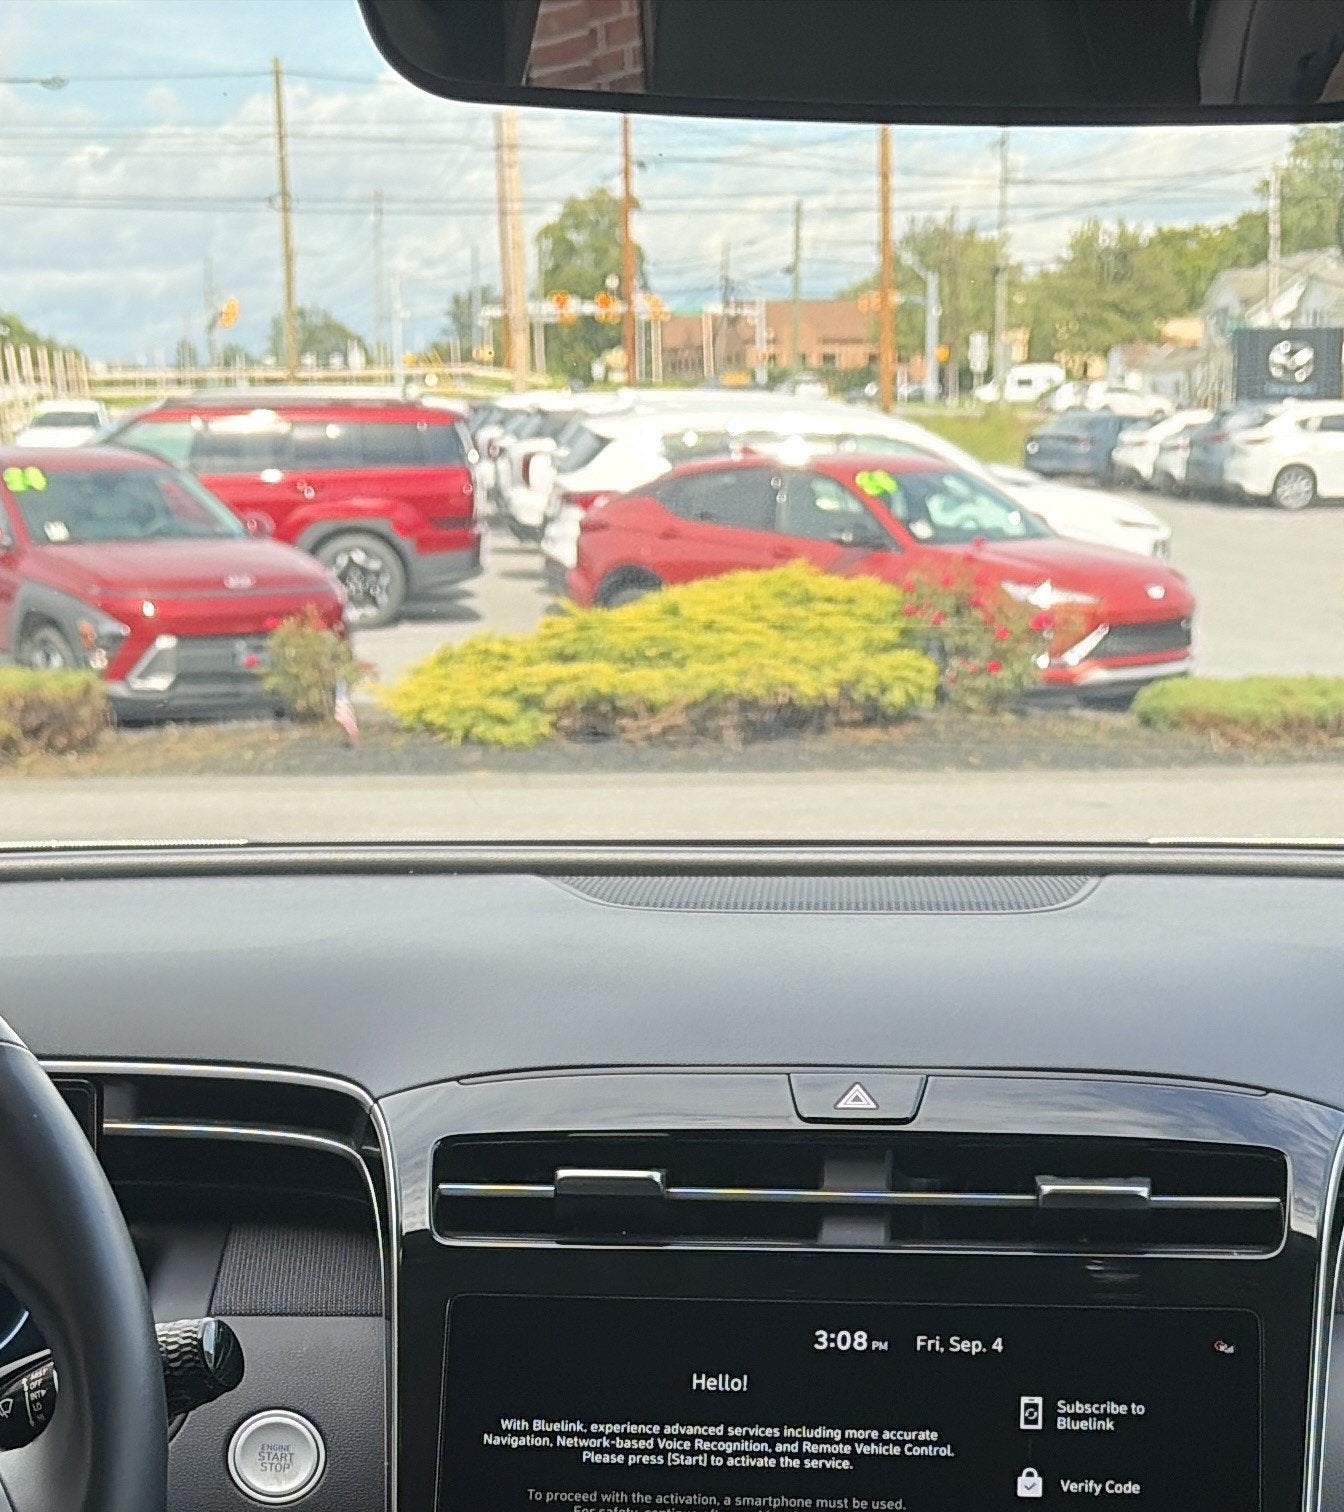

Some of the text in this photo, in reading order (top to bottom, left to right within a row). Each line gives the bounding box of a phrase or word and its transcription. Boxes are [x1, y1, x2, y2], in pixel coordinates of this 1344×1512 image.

[813, 1330, 889, 1351] 3:08 PM
[916, 1335, 1003, 1356] Fri, Sep. 4
[692, 1373, 748, 1392] Hello!
[1056, 1400, 1146, 1416] Subscribe to
[500, 1418, 939, 1441] With Bluelink, experience advanced services including more accurate
[1056, 1416, 1115, 1431] Bluelink
[260, 1443, 292, 1452] ENGINE
[483, 1434, 955, 1457] Navigation, Network-based Voice Recognition, and Remote Vehicle Control.
[258, 1451, 295, 1463] START
[582, 1451, 625, 1464] Please
[628, 1454, 664, 1466] press
[710, 1454, 724, 1466] to
[726, 1455, 776, 1468] activate
[779, 1456, 800, 1468] the
[804, 1457, 853, 1470] service.
[260, 1462, 291, 1473] STOP
[1060, 1479, 1141, 1496] Verify Code
[527, 1488, 907, 1511] To proceed with the activation, a smartphone must be used.
